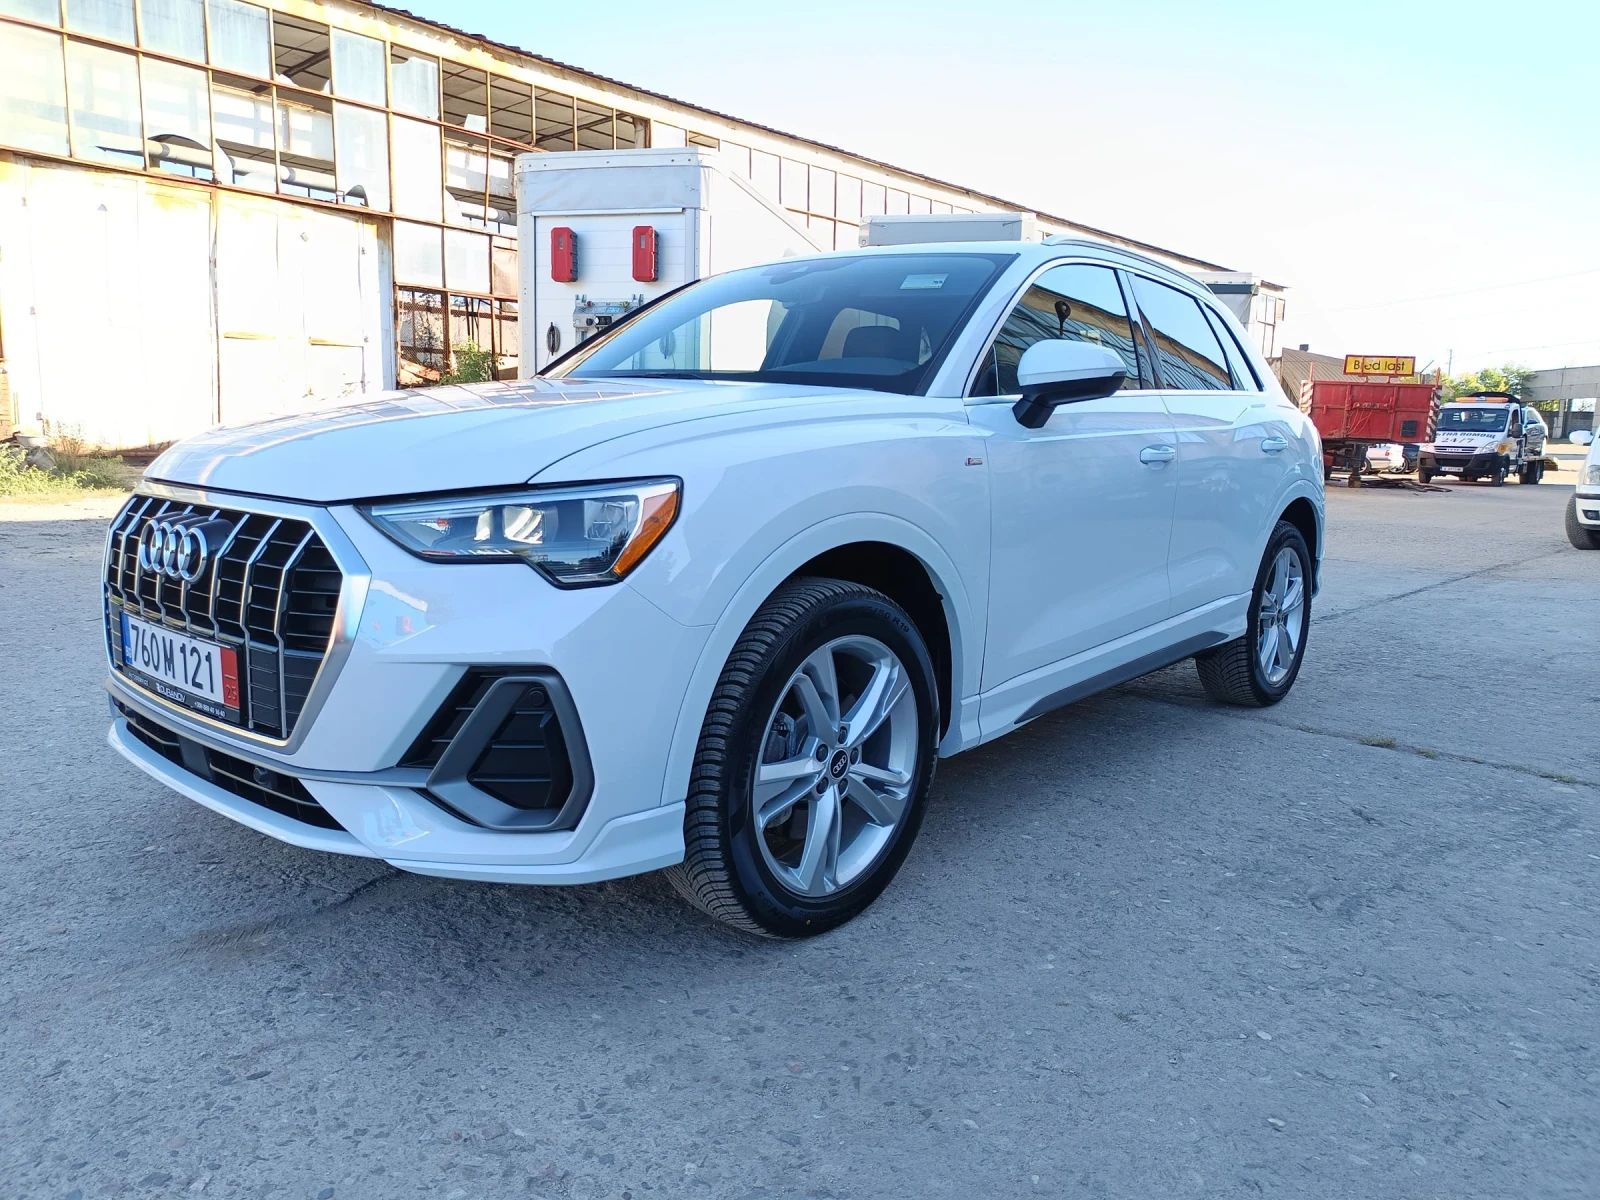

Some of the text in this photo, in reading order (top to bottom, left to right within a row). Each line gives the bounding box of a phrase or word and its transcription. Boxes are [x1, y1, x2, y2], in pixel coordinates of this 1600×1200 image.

[1353, 360, 1405, 371] Bed last
[892, 616, 910, 632] R19
